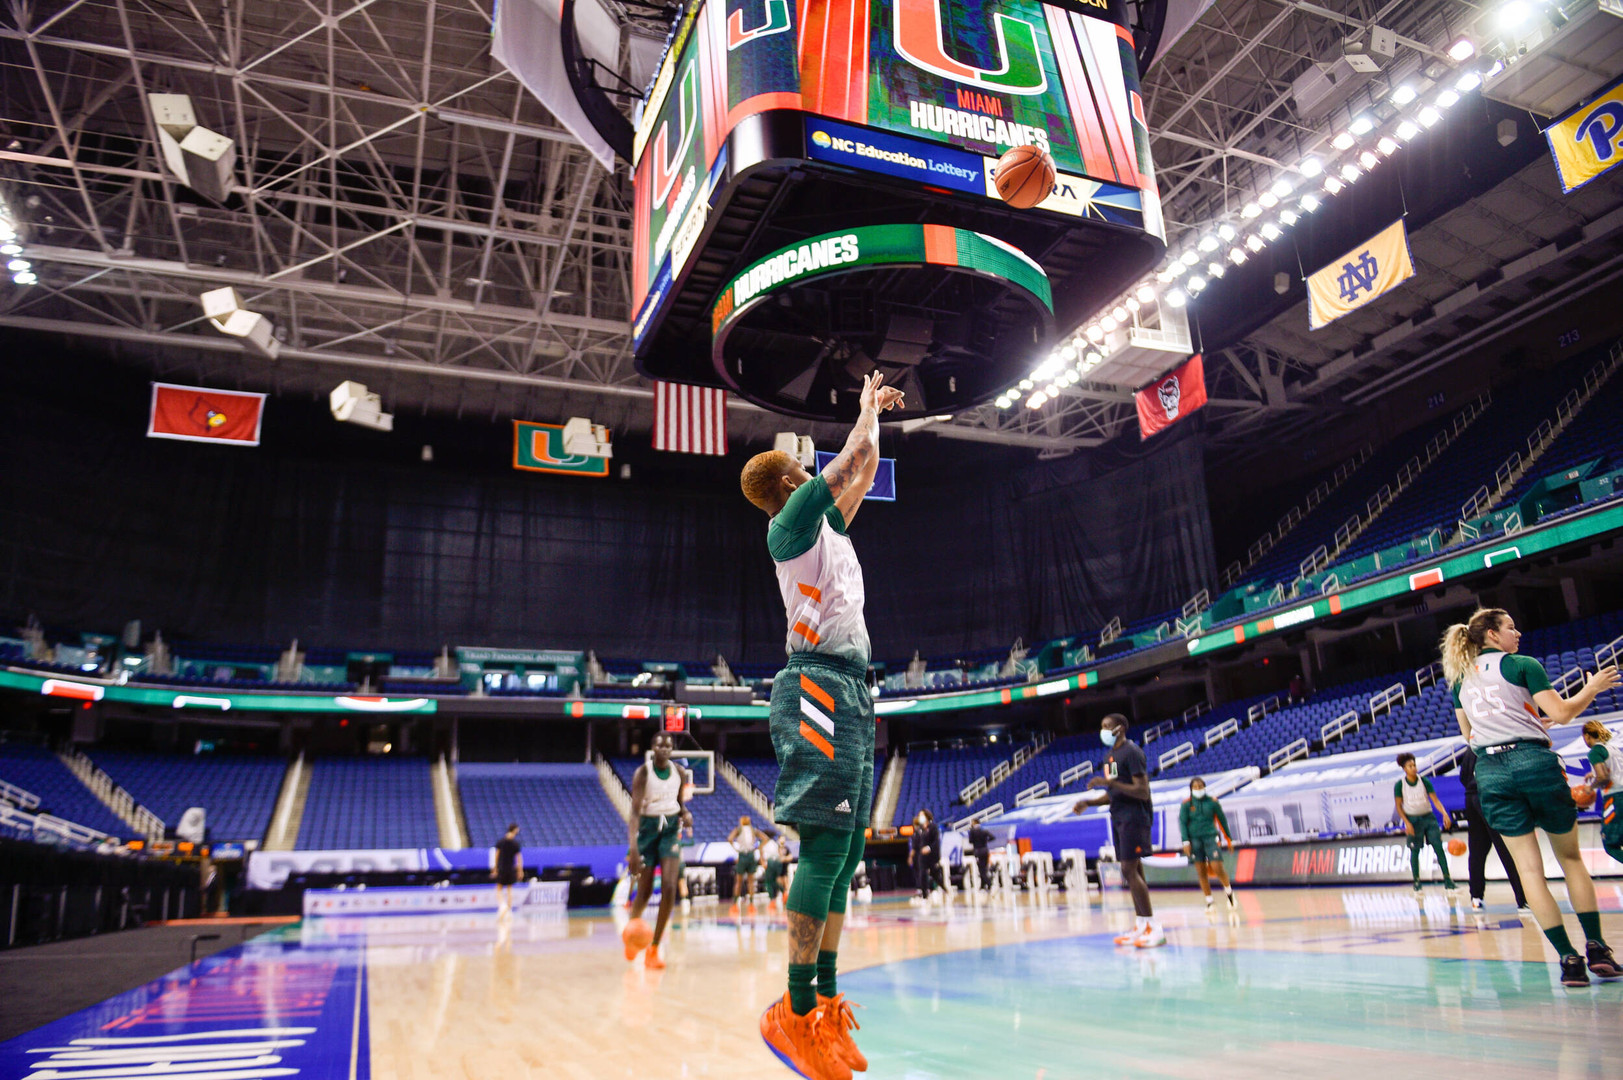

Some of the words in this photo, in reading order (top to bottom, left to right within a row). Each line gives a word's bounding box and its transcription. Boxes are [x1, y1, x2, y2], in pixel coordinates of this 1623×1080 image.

[956, 88, 1003, 117] MIAMI
[910, 101, 1050, 154] HURRICANES
[832, 137, 854, 153] NC
[855, 143, 927, 170] Education
[928, 159, 976, 182] Lottery
[734, 234, 860, 307] HURRICANES
[1558, 328, 1581, 348] 213
[1427, 392, 1445, 409] 214
[1467, 683, 1506, 718] 25
[1291, 848, 1336, 876] MIAMI
